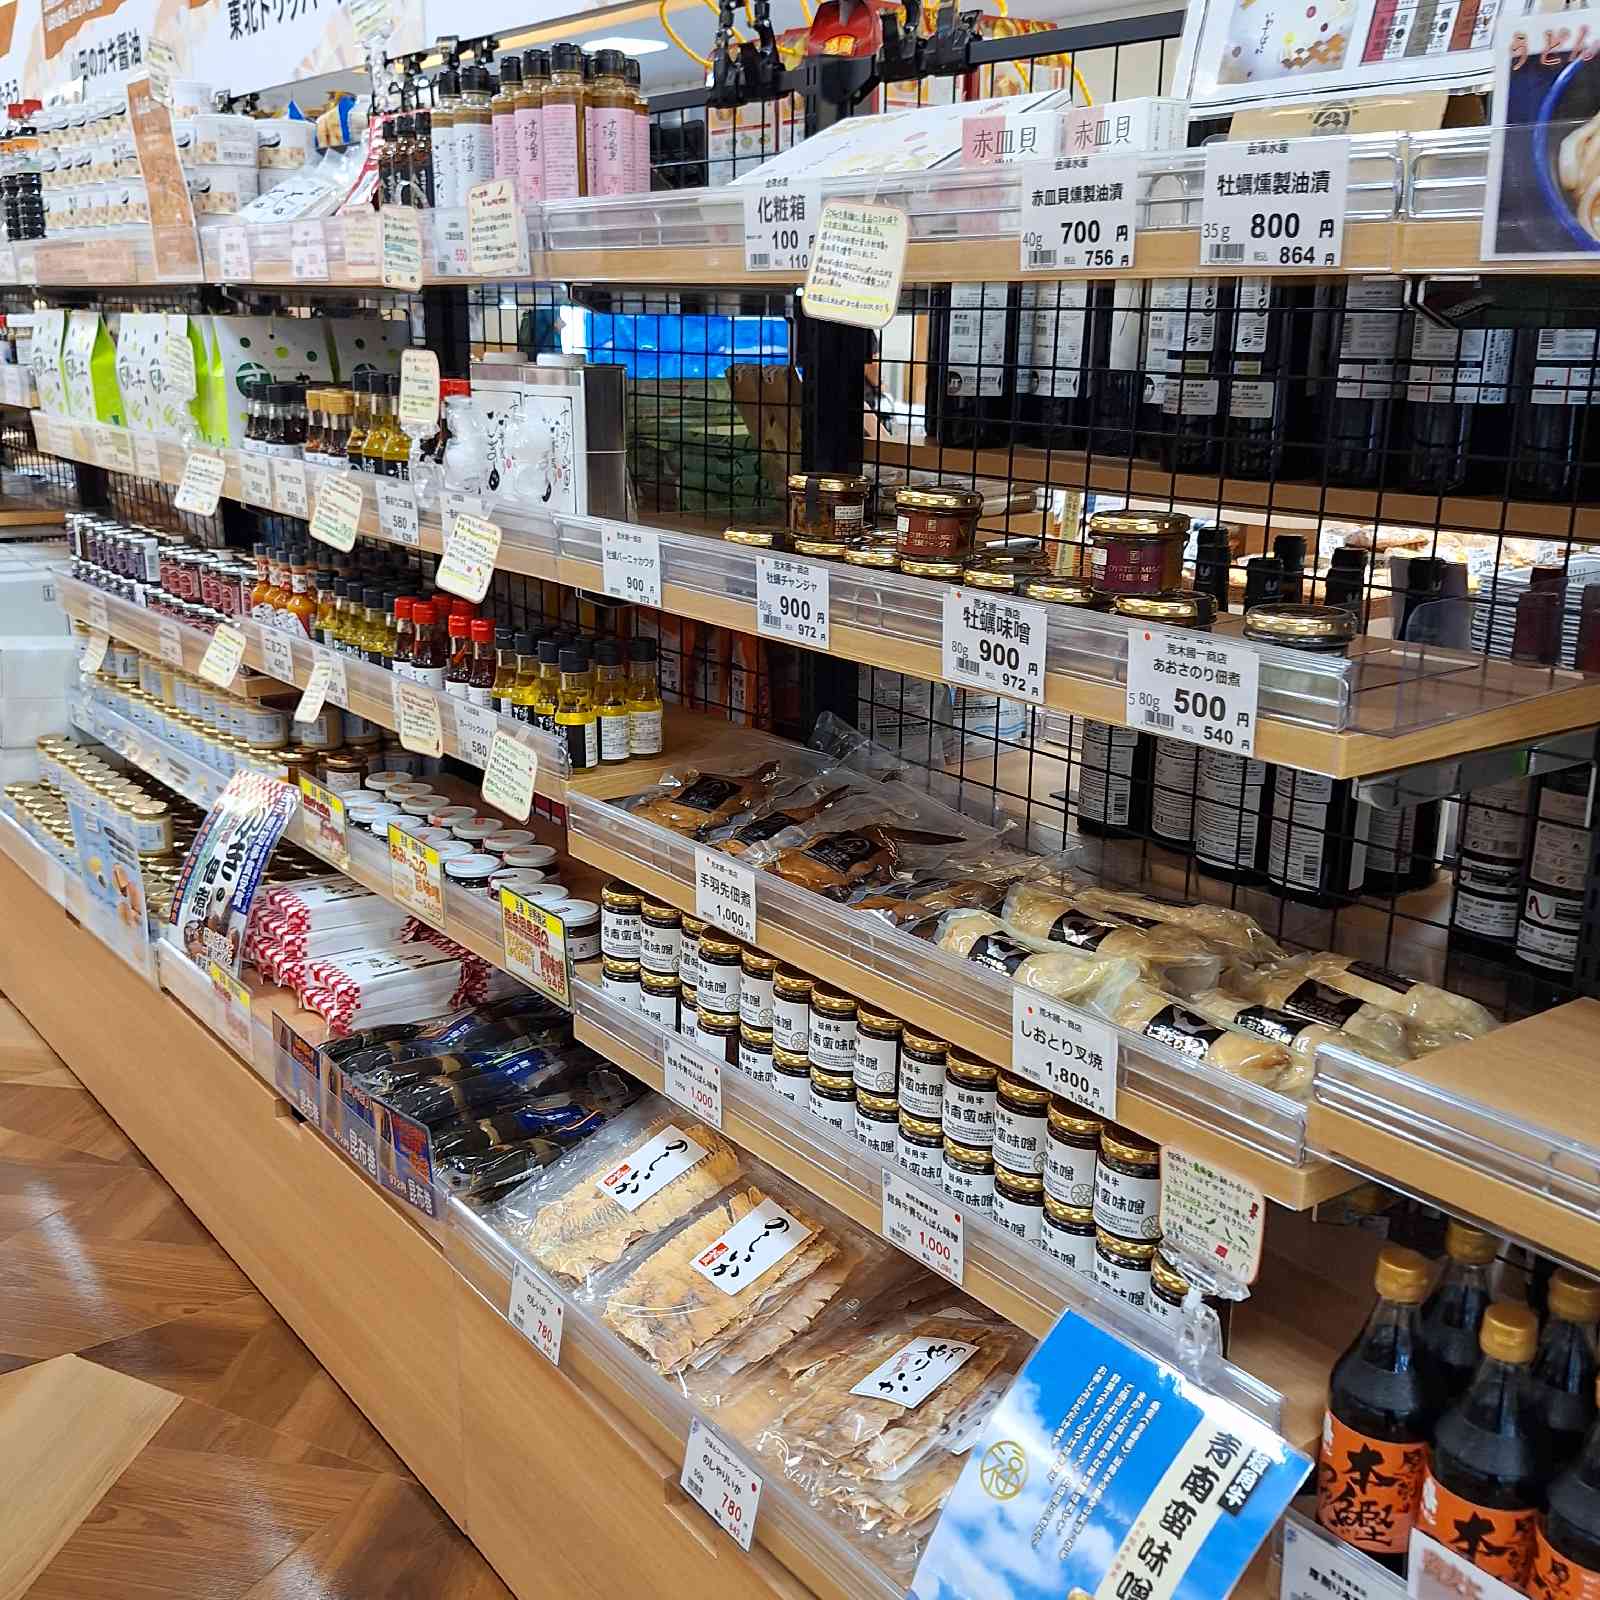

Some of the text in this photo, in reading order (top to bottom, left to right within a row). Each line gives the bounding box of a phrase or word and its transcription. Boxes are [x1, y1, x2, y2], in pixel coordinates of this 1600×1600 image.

[972, 126, 1036, 159] 赤皿貝
[1074, 115, 1131, 150] 赤皿貝
[757, 194, 806, 224] 化粧箱
[1060, 220, 1129, 245] 700 円
[1250, 213, 1334, 239] 800 円
[772, 230, 799, 249] 100
[1022, 232, 1042, 250] 40g
[789, 254, 808, 268] 110
[1084, 249, 1113, 266] 756
[1280, 246, 1315, 264] 864
[627, 576, 644, 592] 900
[780, 595, 810, 620] 900
[798, 624, 816, 638] 972
[963, 606, 1031, 645] 牡蠣味噌
[979, 639, 1037, 676] 900 円
[1002, 673, 1026, 691] 972
[1153, 658, 1241, 688] あおさのり佃煮
[1139, 692, 1160, 712] 80g
[1174, 688, 1249, 728] 500 円
[1204, 726, 1233, 745] 540
[717, 905, 744, 926] 1,000
[1021, 1019, 1103, 1070] しおとり叉焼
[1045, 1061, 1089, 1092] 1,800
[712, 1216, 790, 1278] のしいか
[722, 1492, 742, 1522] 780
